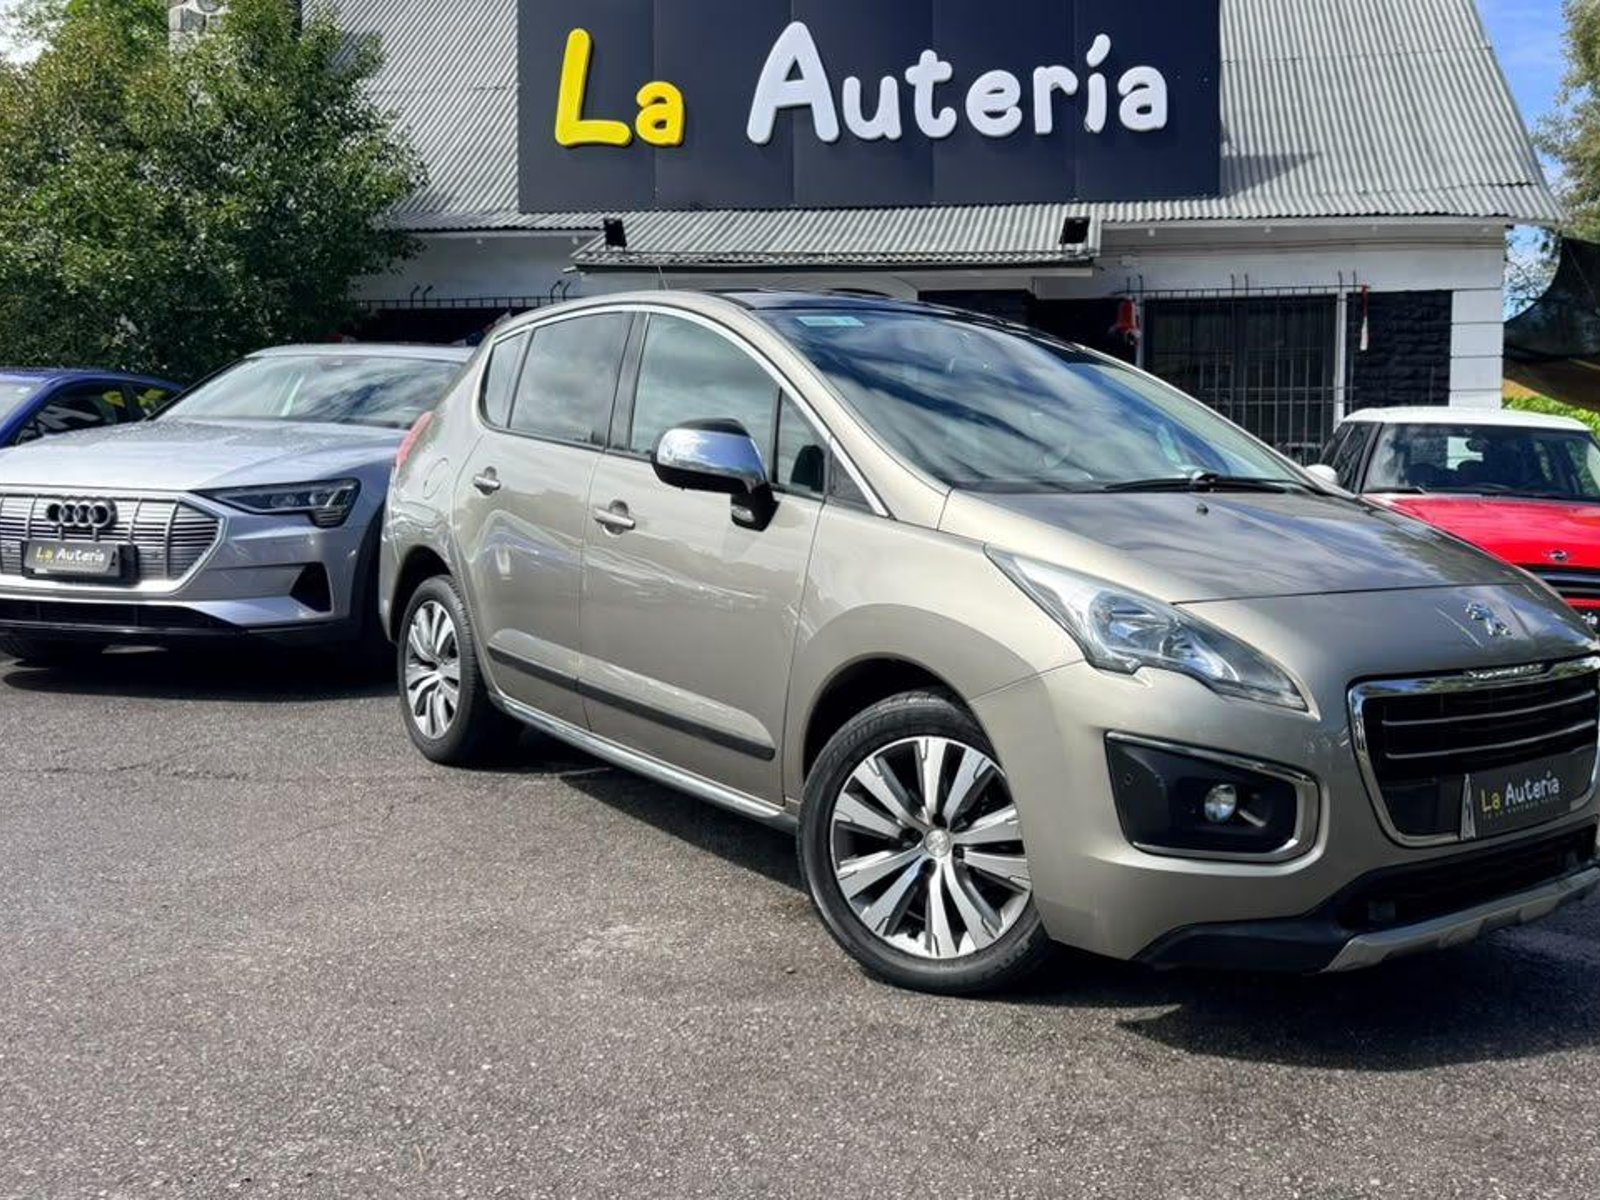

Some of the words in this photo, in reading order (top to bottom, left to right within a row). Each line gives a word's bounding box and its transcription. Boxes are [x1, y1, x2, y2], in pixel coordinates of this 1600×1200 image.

[555, 28, 684, 146] La
[747, 21, 1168, 143] Autería
[36, 546, 54, 560] La
[1480, 789, 1501, 812] La
